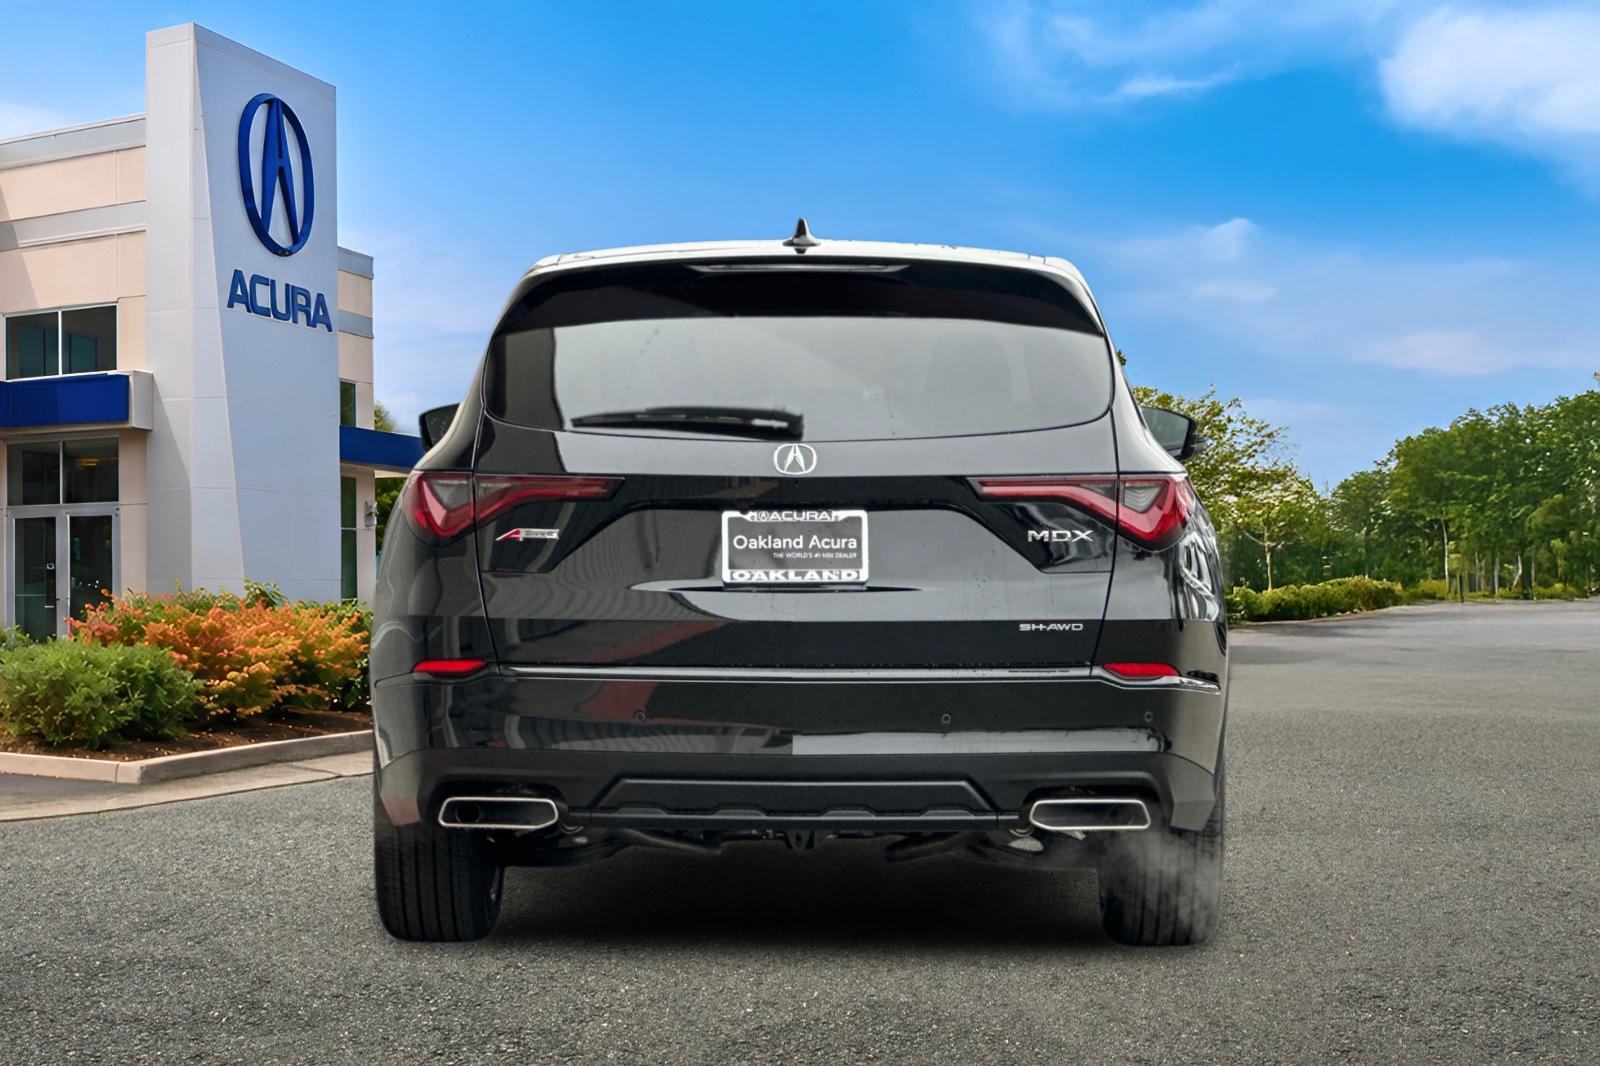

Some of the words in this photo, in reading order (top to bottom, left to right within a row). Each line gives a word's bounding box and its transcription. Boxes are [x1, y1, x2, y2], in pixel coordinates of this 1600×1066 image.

[227, 268, 333, 332] ACURA
[769, 509, 832, 521] ACURA
[733, 534, 804, 549] Oakland
[808, 534, 858, 549] Acura
[1027, 529, 1094, 542] MDX
[731, 569, 859, 581] OAKLAND
[1019, 623, 1084, 632] SH-AWD
